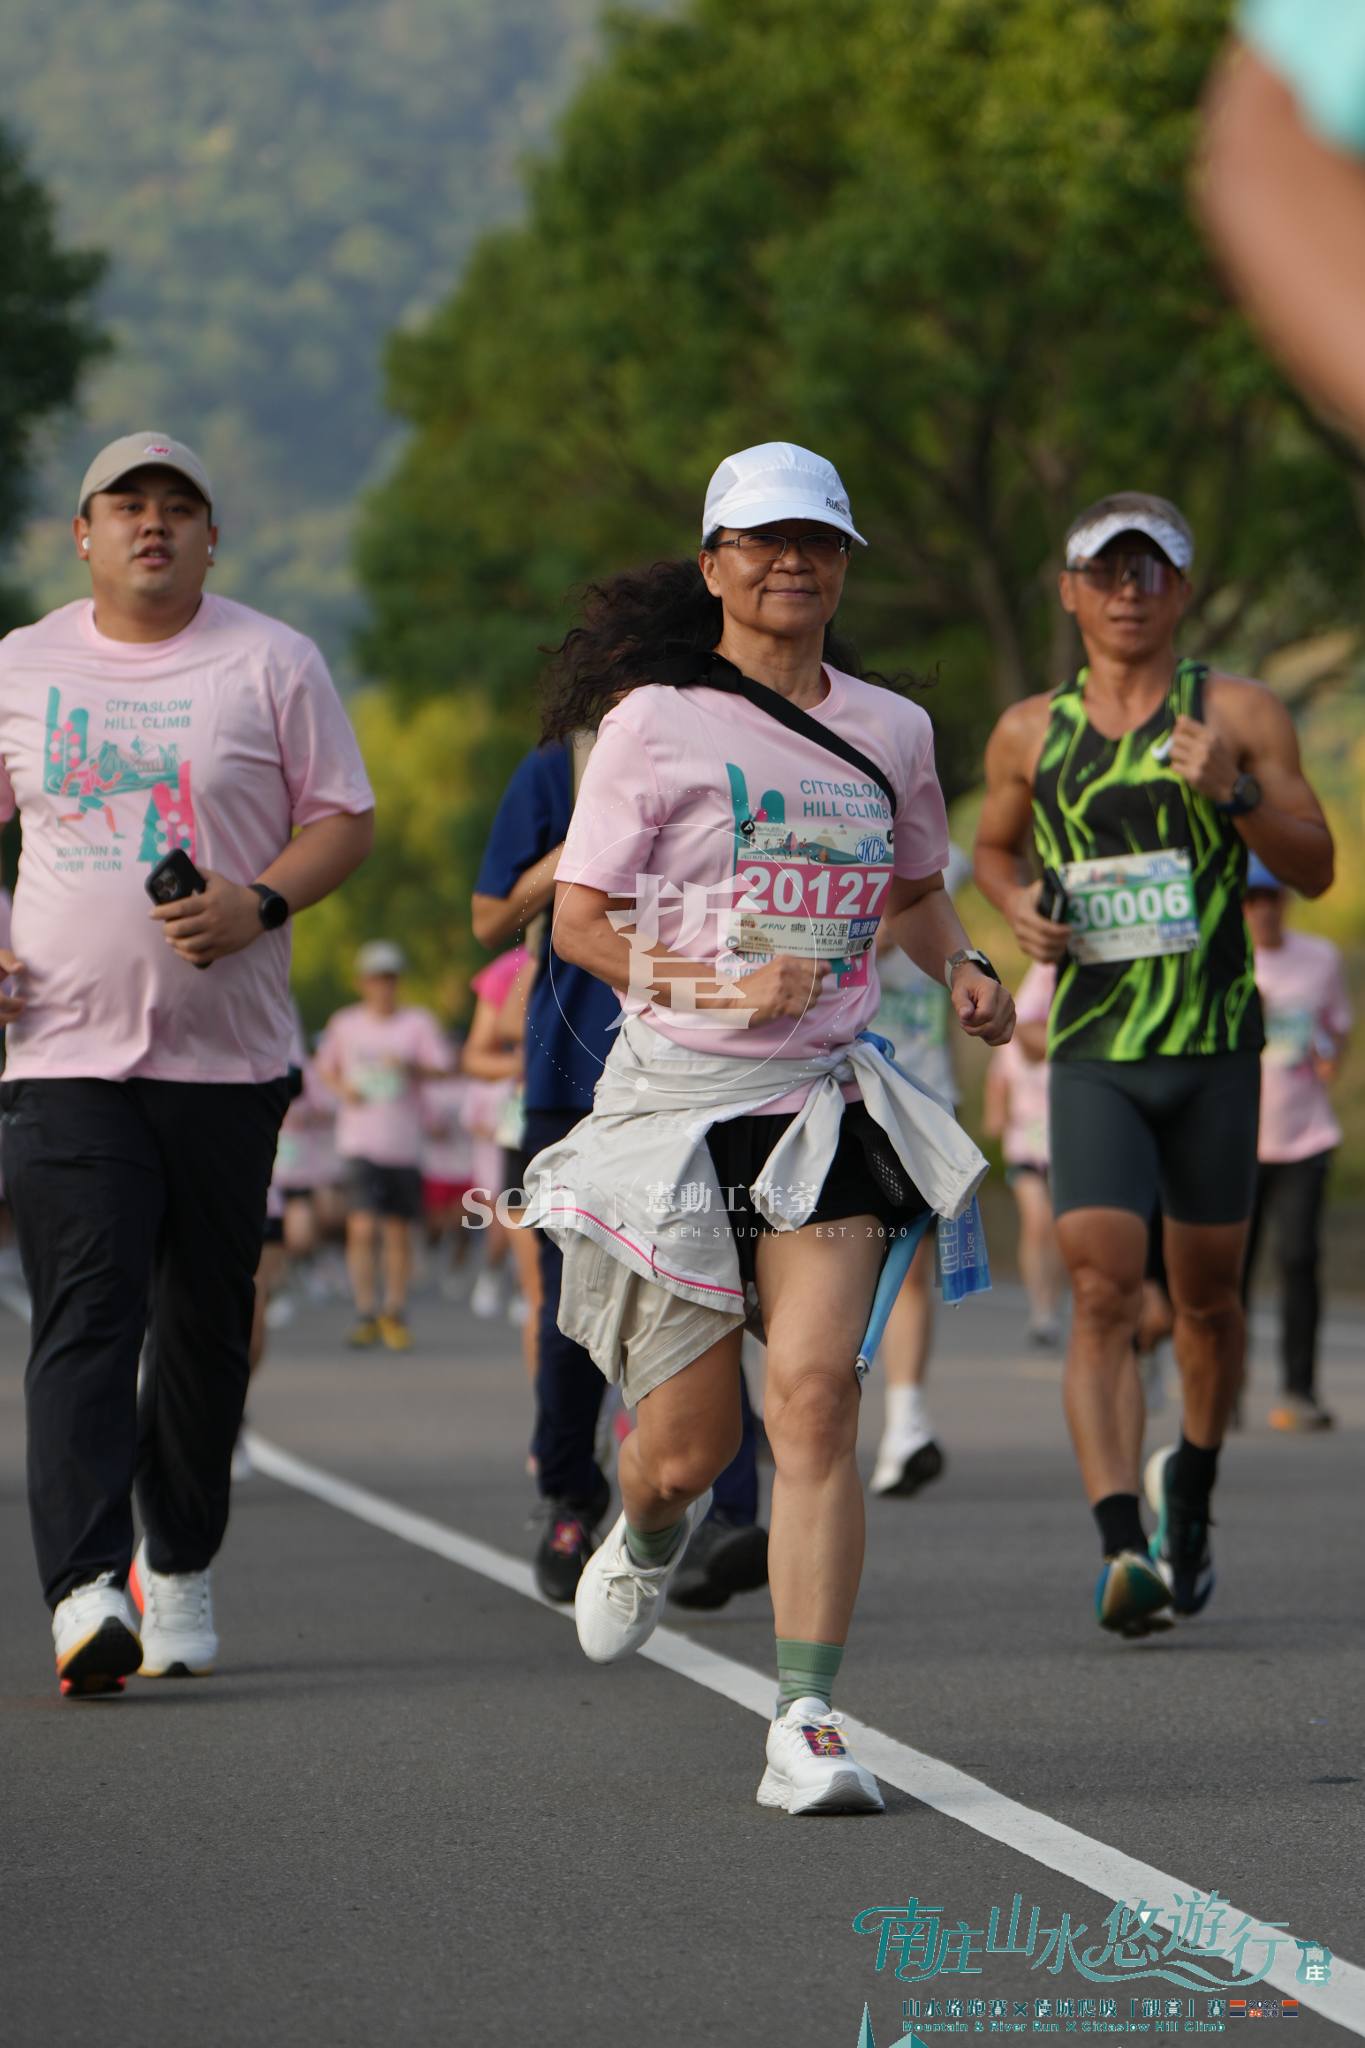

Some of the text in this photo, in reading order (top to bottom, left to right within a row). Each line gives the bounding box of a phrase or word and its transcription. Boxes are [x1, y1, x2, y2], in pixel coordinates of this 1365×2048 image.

[105, 699, 192, 712] CITTASLOW
[104, 716, 191, 729] HILL CLIMB
[803, 801, 841, 817] HILL
[93, 860, 122, 872] RUN
[738, 866, 890, 915] 20127
[1068, 883, 1190, 930] 30006
